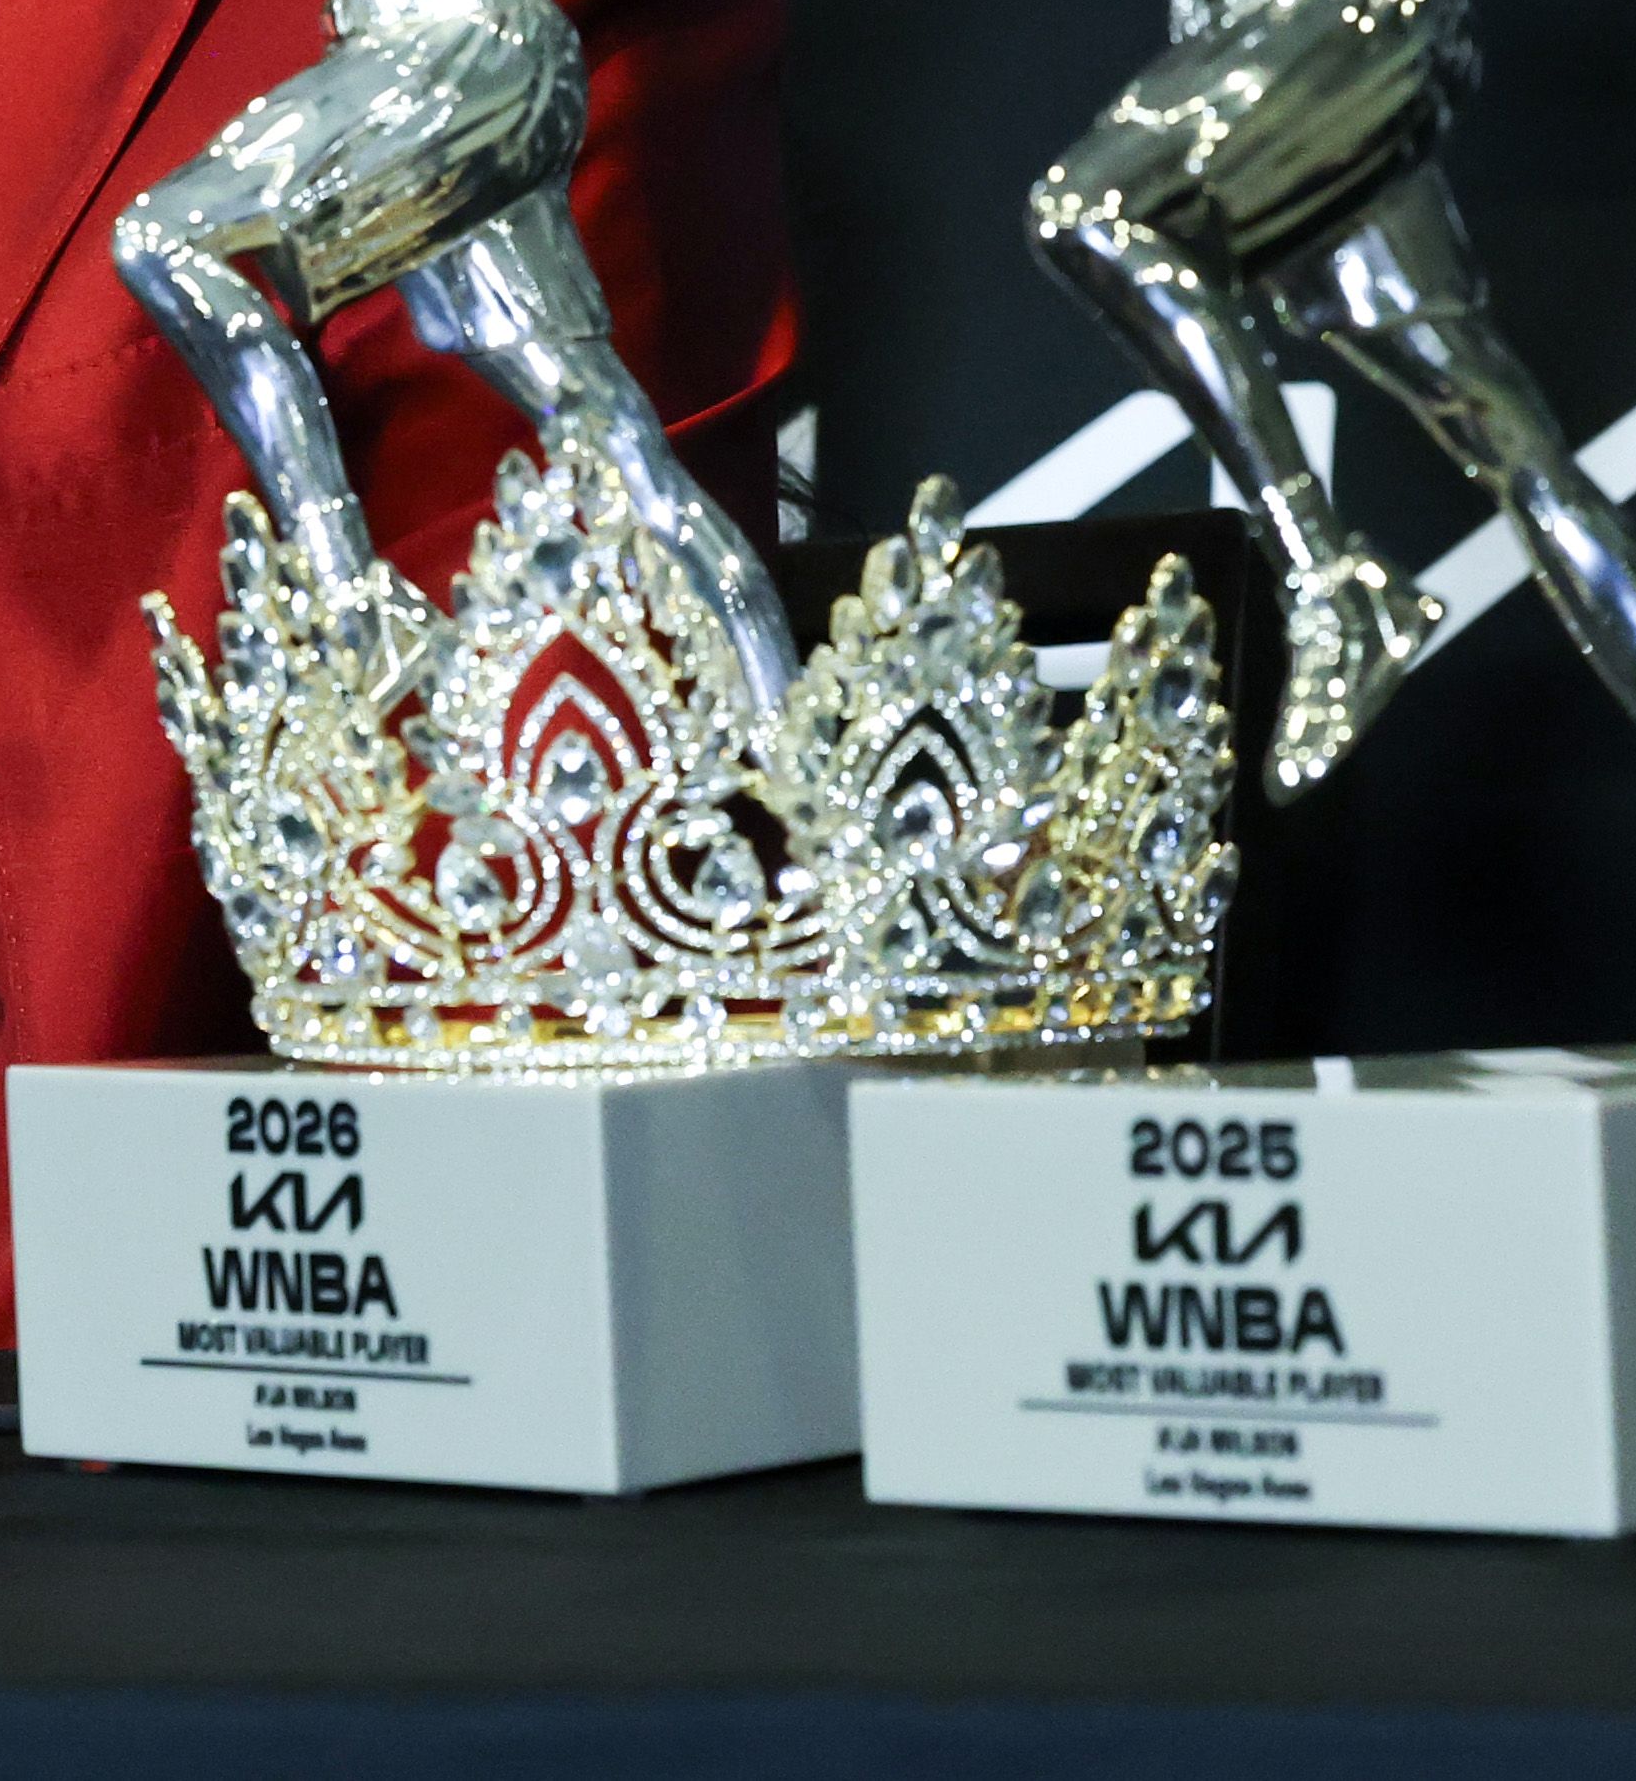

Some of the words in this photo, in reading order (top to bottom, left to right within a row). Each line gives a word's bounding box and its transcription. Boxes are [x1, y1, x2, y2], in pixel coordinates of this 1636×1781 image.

[226, 1096, 361, 1159] 2026
[1129, 1117, 1301, 1182] 2025
[229, 1170, 365, 1235] KIA
[1132, 1199, 1303, 1267] KIA
[202, 1245, 399, 1319] WNBA
[1097, 1281, 1345, 1356] WNBA
